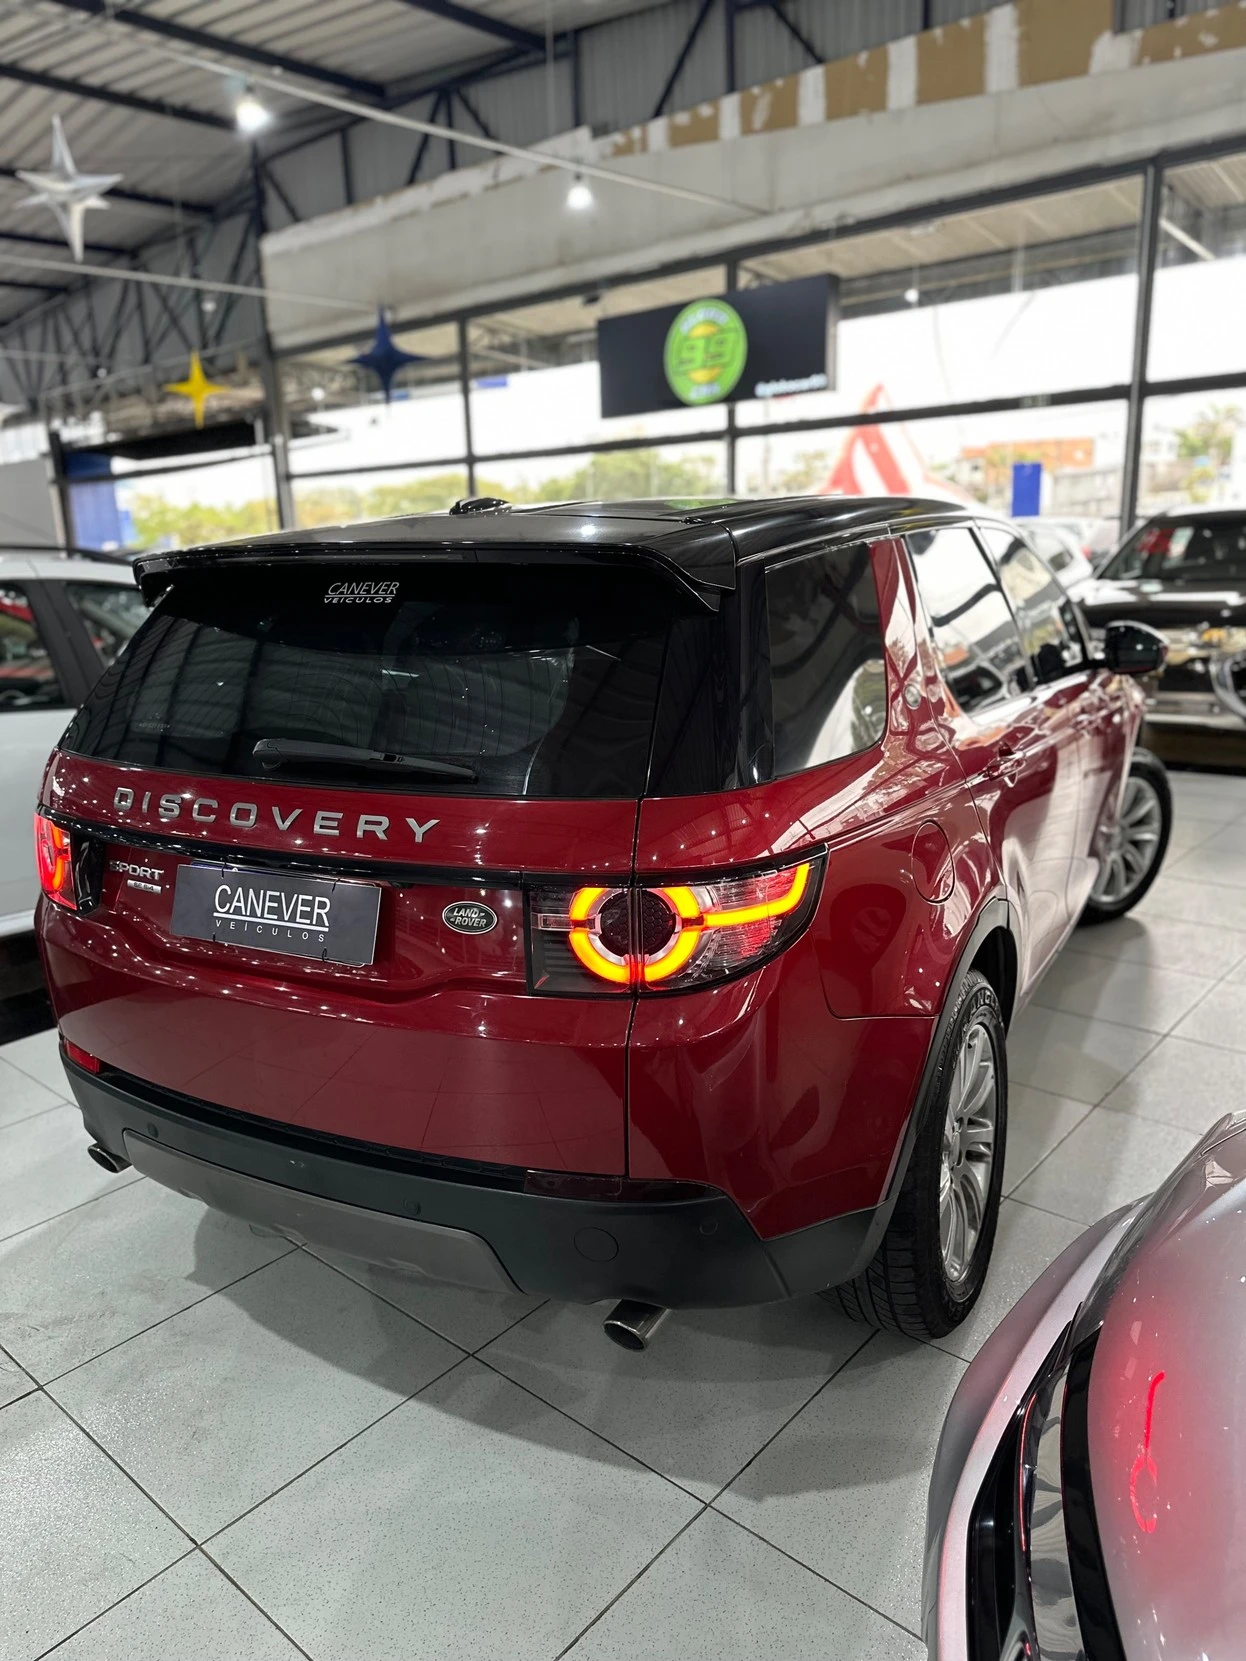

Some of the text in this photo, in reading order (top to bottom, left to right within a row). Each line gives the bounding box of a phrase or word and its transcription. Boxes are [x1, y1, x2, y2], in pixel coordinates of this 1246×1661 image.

[328, 582, 400, 594] CANEVER
[113, 787, 441, 843] DISCOVERY
[110, 861, 165, 880] SPORT
[214, 884, 331, 927] CANEVER
[453, 907, 480, 918] LAND
[454, 916, 487, 928] ROVER
